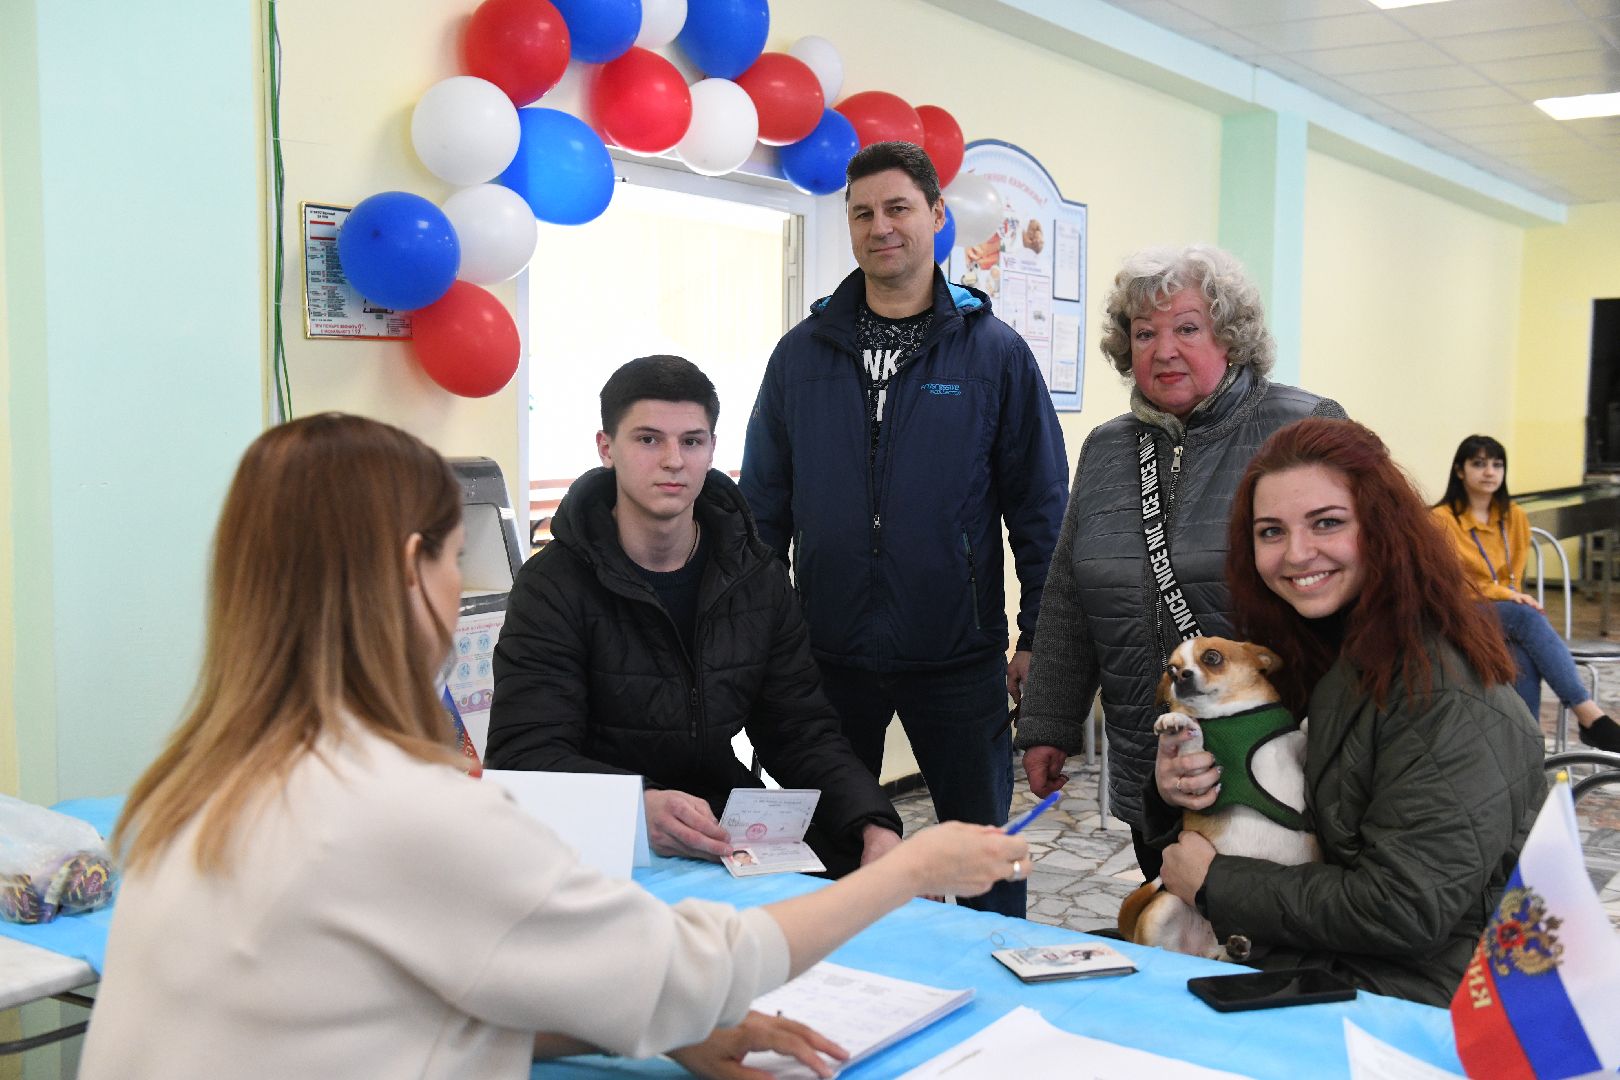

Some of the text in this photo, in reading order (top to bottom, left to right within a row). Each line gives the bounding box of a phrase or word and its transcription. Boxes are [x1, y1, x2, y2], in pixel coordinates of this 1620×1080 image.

[1140, 461, 1159, 493] NICE
[1149, 548, 1177, 591] NICE
[1163, 588, 1197, 632] NICE
